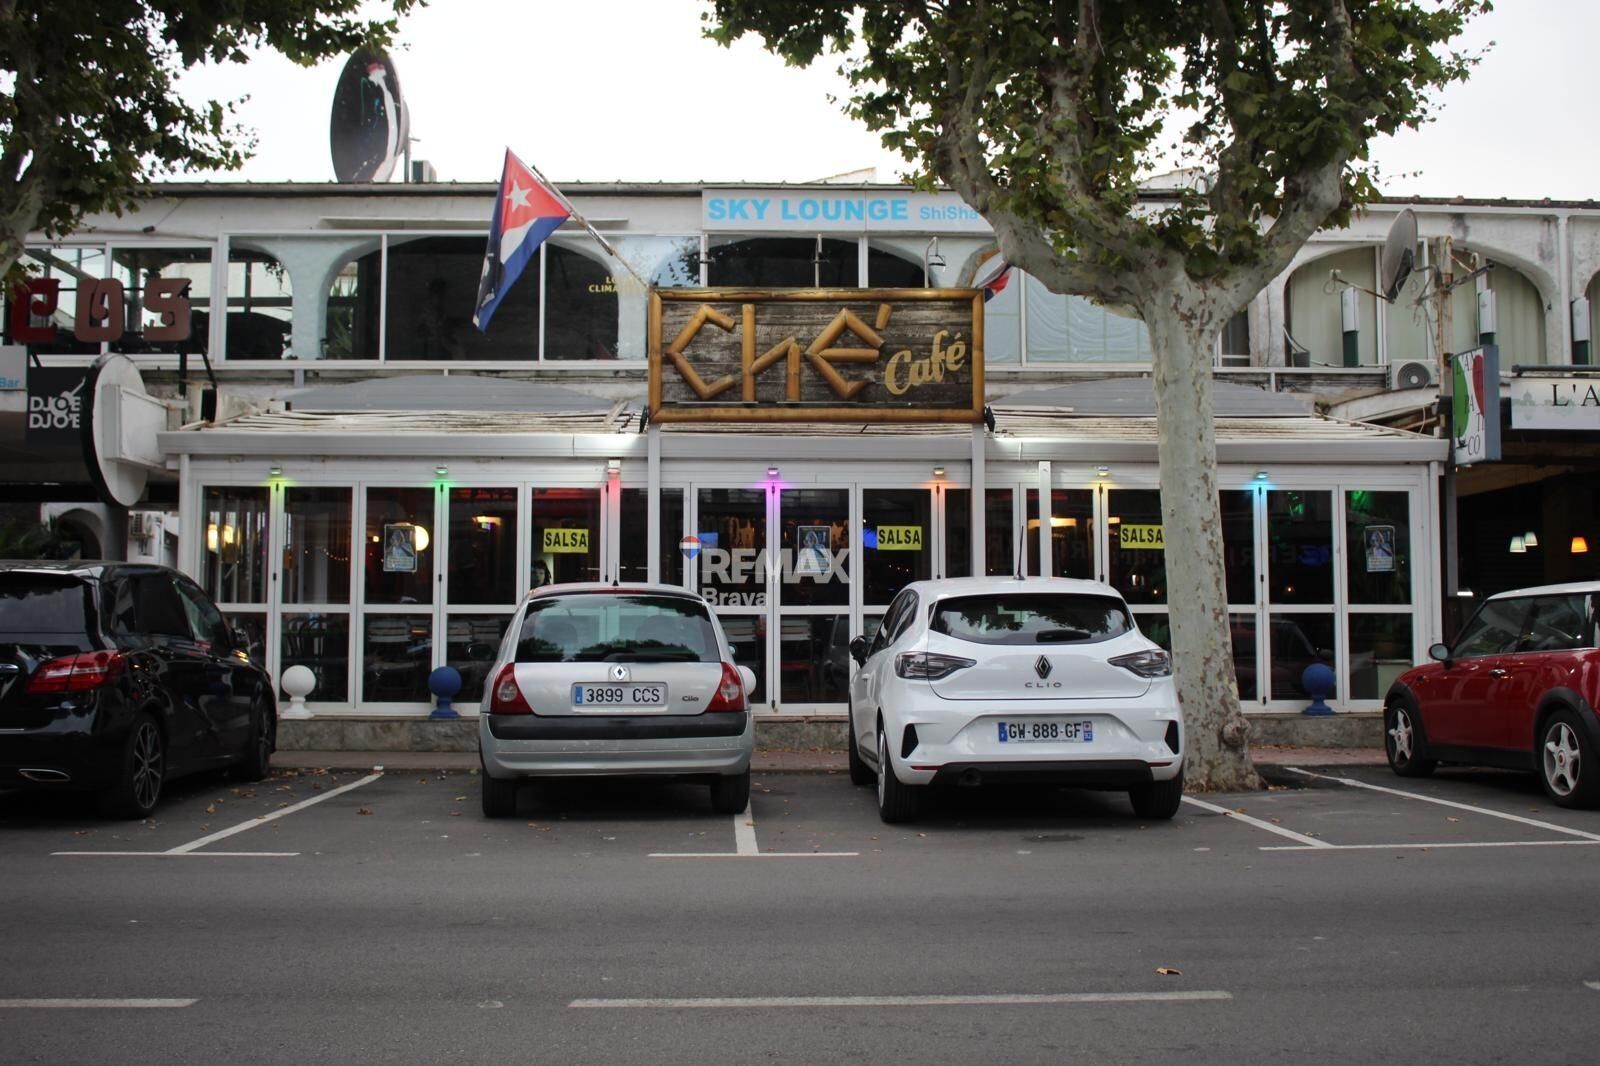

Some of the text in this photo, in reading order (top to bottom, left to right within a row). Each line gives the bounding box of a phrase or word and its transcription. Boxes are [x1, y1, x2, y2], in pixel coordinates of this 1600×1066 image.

[708, 199, 978, 221] SKY LOUNGE ShiSha
[885, 330, 966, 395] Café
[544, 532, 588, 548] SALSA
[878, 529, 921, 545] SALSA
[1121, 527, 1164, 543] SALSA
[586, 688, 661, 703] 3899 CCS
[1009, 723, 1082, 739] GW-888-GF
